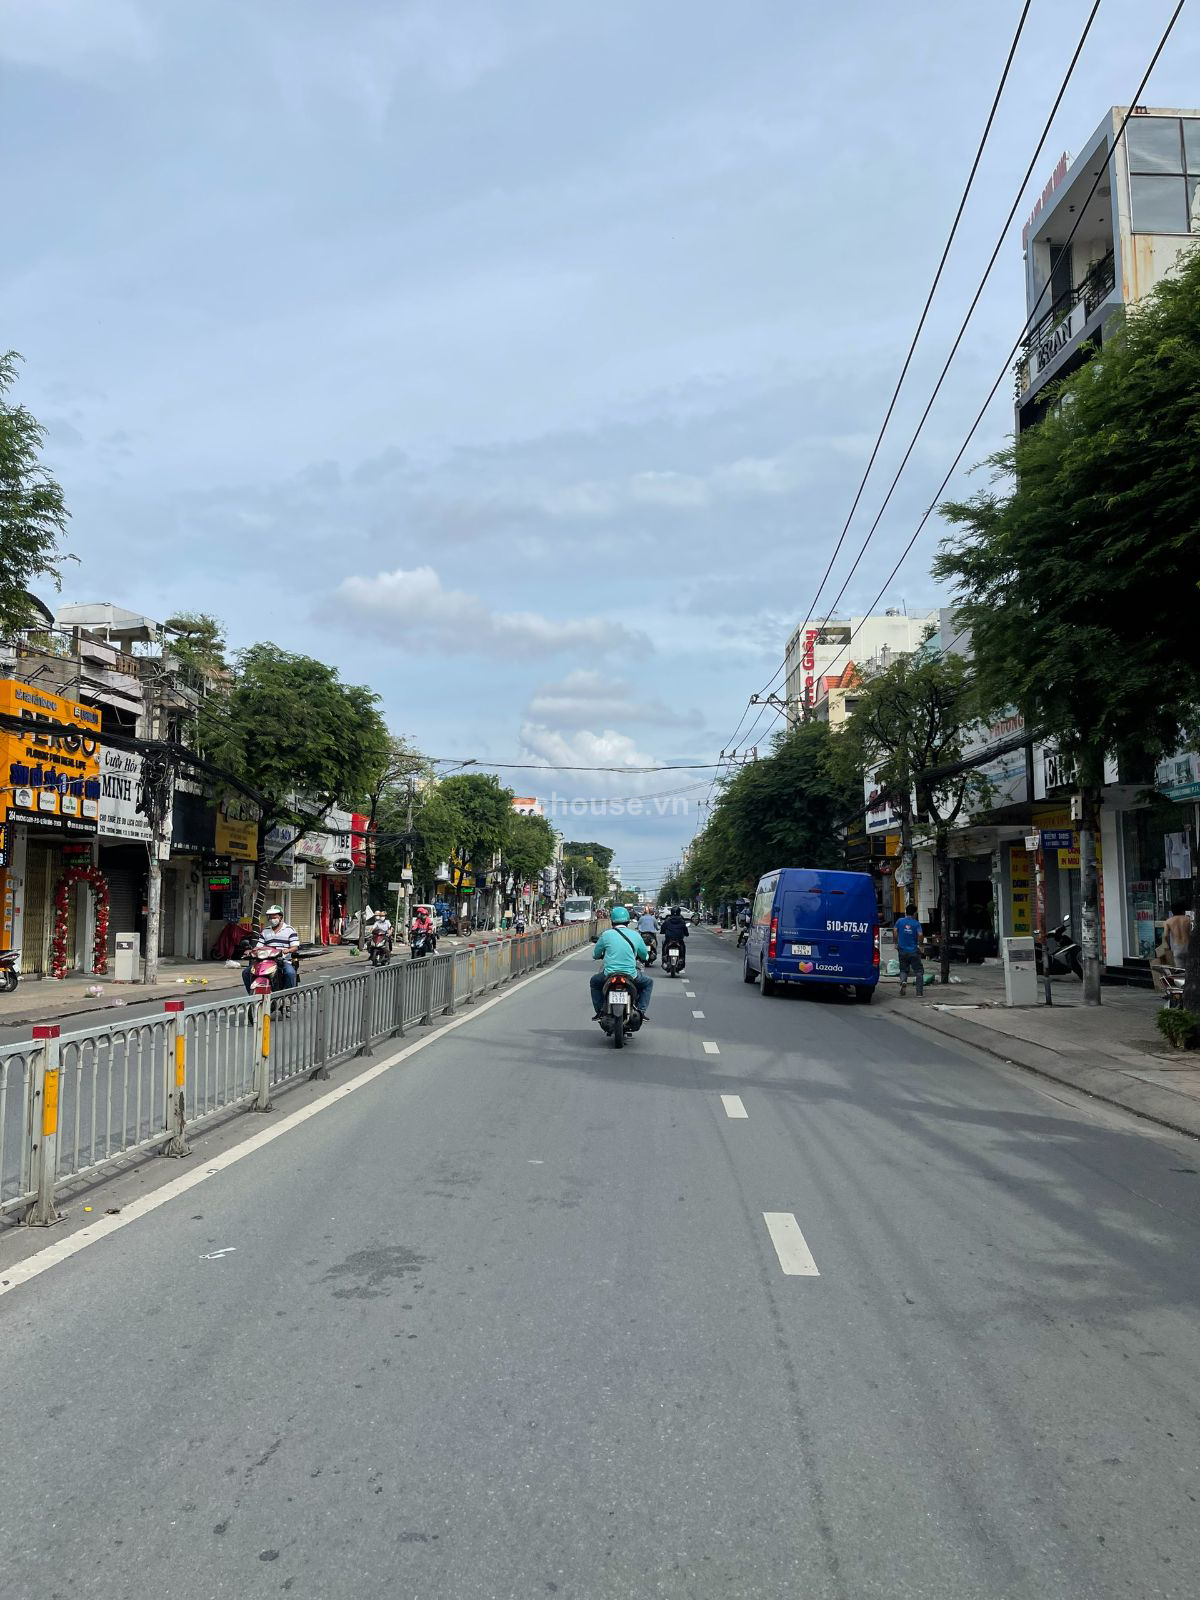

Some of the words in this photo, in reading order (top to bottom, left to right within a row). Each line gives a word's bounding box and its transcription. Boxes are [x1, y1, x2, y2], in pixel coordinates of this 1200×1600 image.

[102, 774, 131, 802] MINH
[827, 920, 869, 934] 51D-675.47
[815, 962, 843, 972] Lazada
